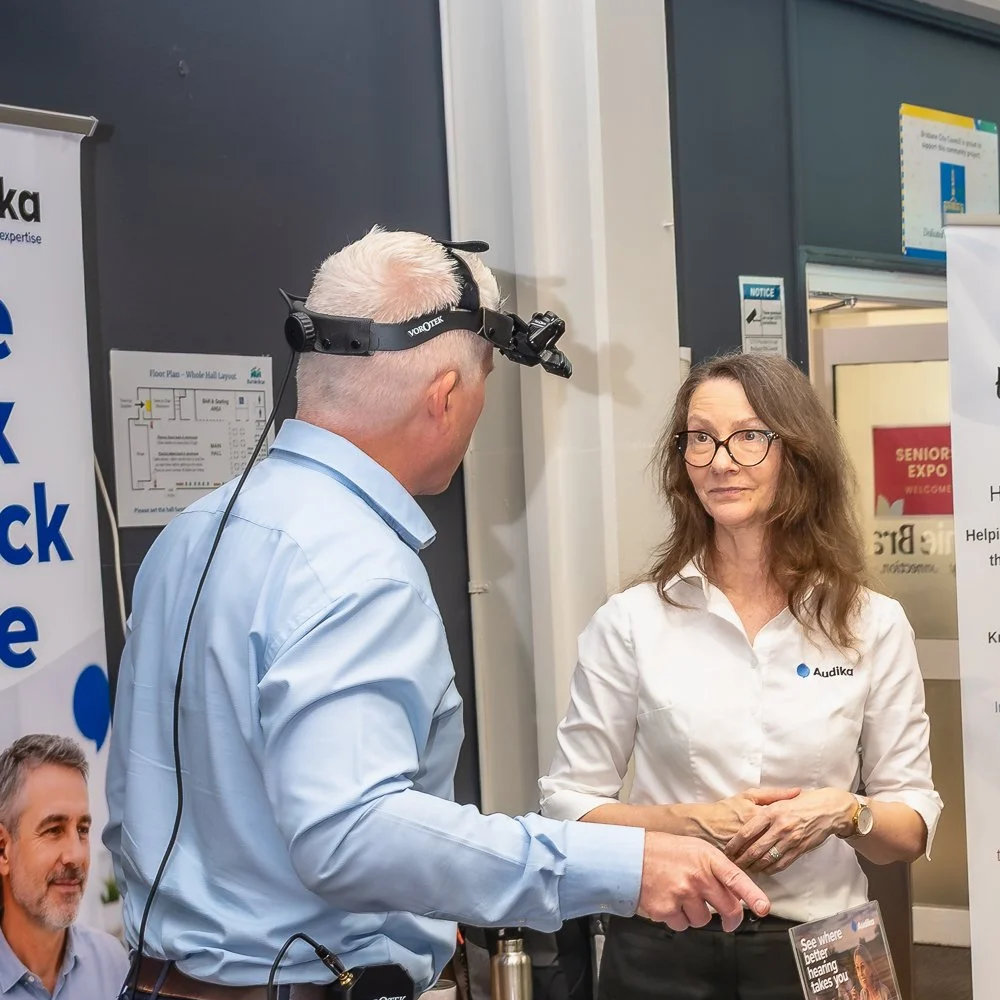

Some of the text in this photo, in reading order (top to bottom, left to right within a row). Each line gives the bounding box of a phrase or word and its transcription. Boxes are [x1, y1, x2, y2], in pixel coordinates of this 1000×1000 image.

[750, 287, 775, 298] NOTICE
[408, 316, 444, 337] VOROTEK
[150, 370, 166, 378] Floor
[218, 372, 237, 381] Layout
[896, 446, 951, 461] SENIOR
[908, 464, 947, 478] EXPO
[813, 666, 854, 677] Audika
[857, 919, 875, 930] Audika
[800, 928, 843, 952] See where
[804, 948, 828, 965] better
[806, 960, 838, 979] hearing
[811, 971, 849, 994] takes you
